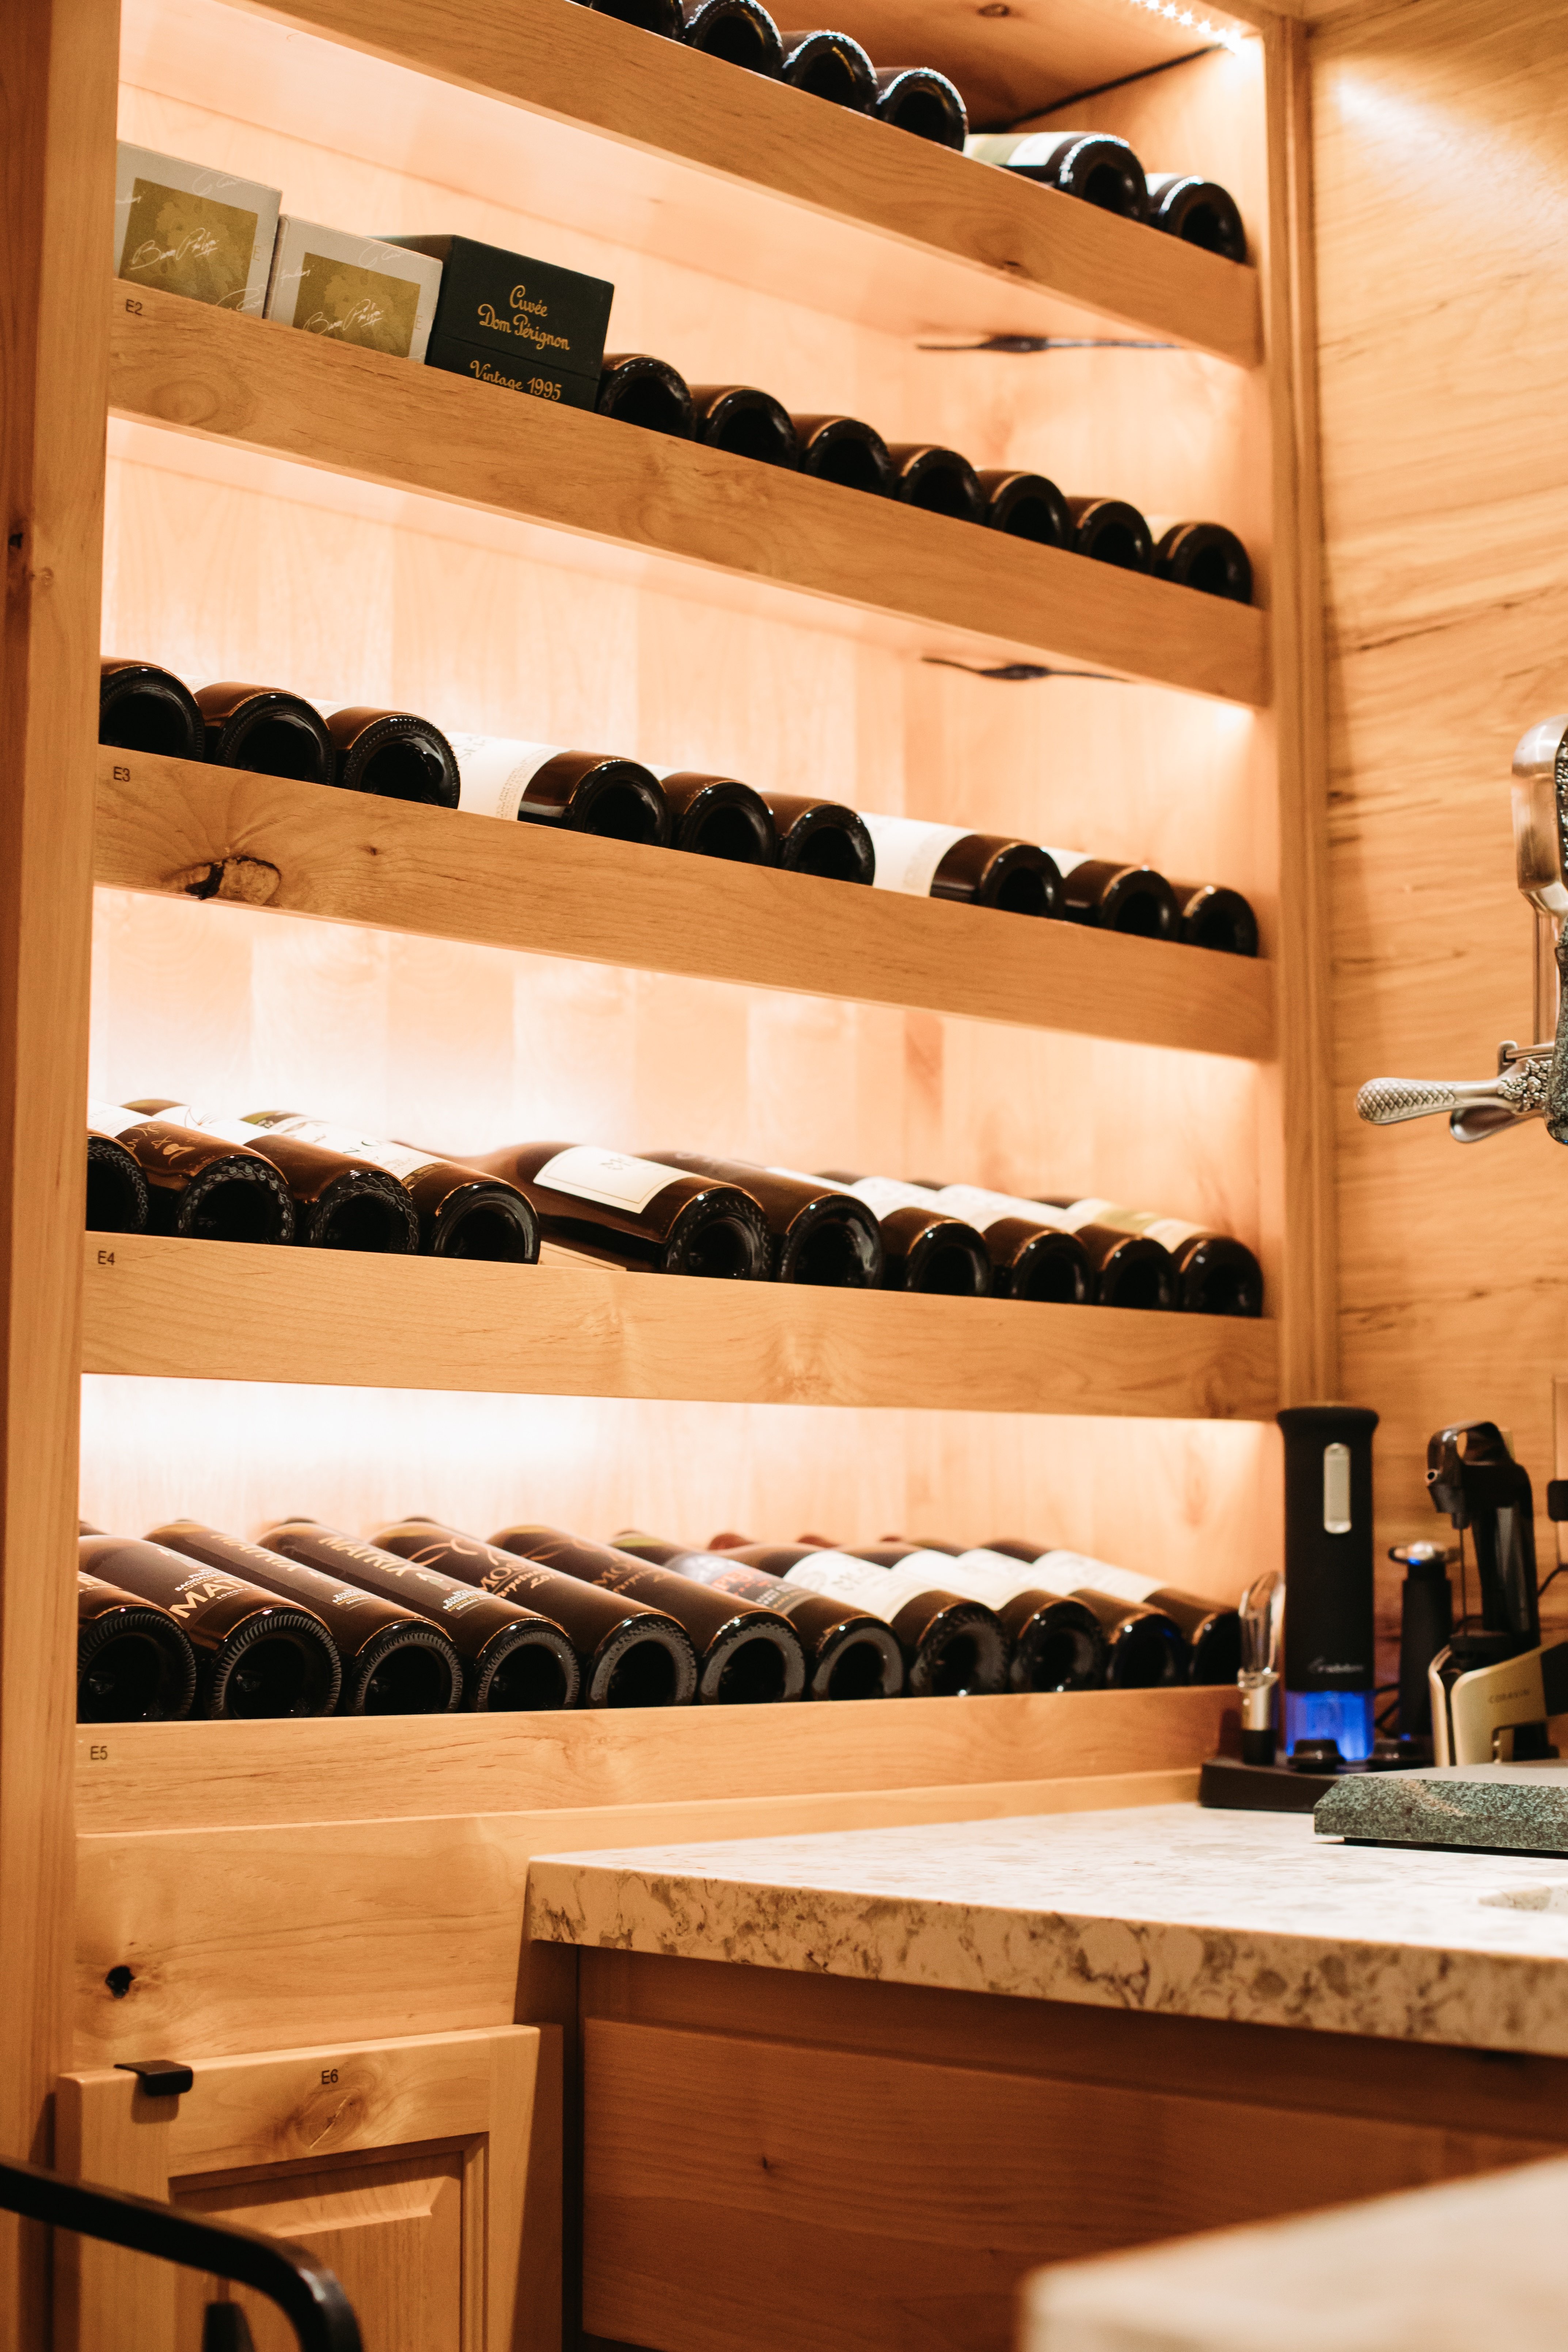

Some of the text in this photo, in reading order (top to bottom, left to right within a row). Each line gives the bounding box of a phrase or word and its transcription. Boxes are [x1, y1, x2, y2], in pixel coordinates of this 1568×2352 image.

[126, 299, 143, 316] E2
[509, 285, 548, 316] Cuvée
[478, 304, 570, 350] Dom Pérignon
[470, 360, 562, 400] Vintage 1995
[114, 767, 130, 782] E3
[98, 1250, 115, 1265] E4
[318, 1535, 419, 1577] MATRIX
[216, 1588, 251, 1599] SONOMA
[90, 1745, 108, 1760] E5
[322, 2068, 338, 2085] E6
